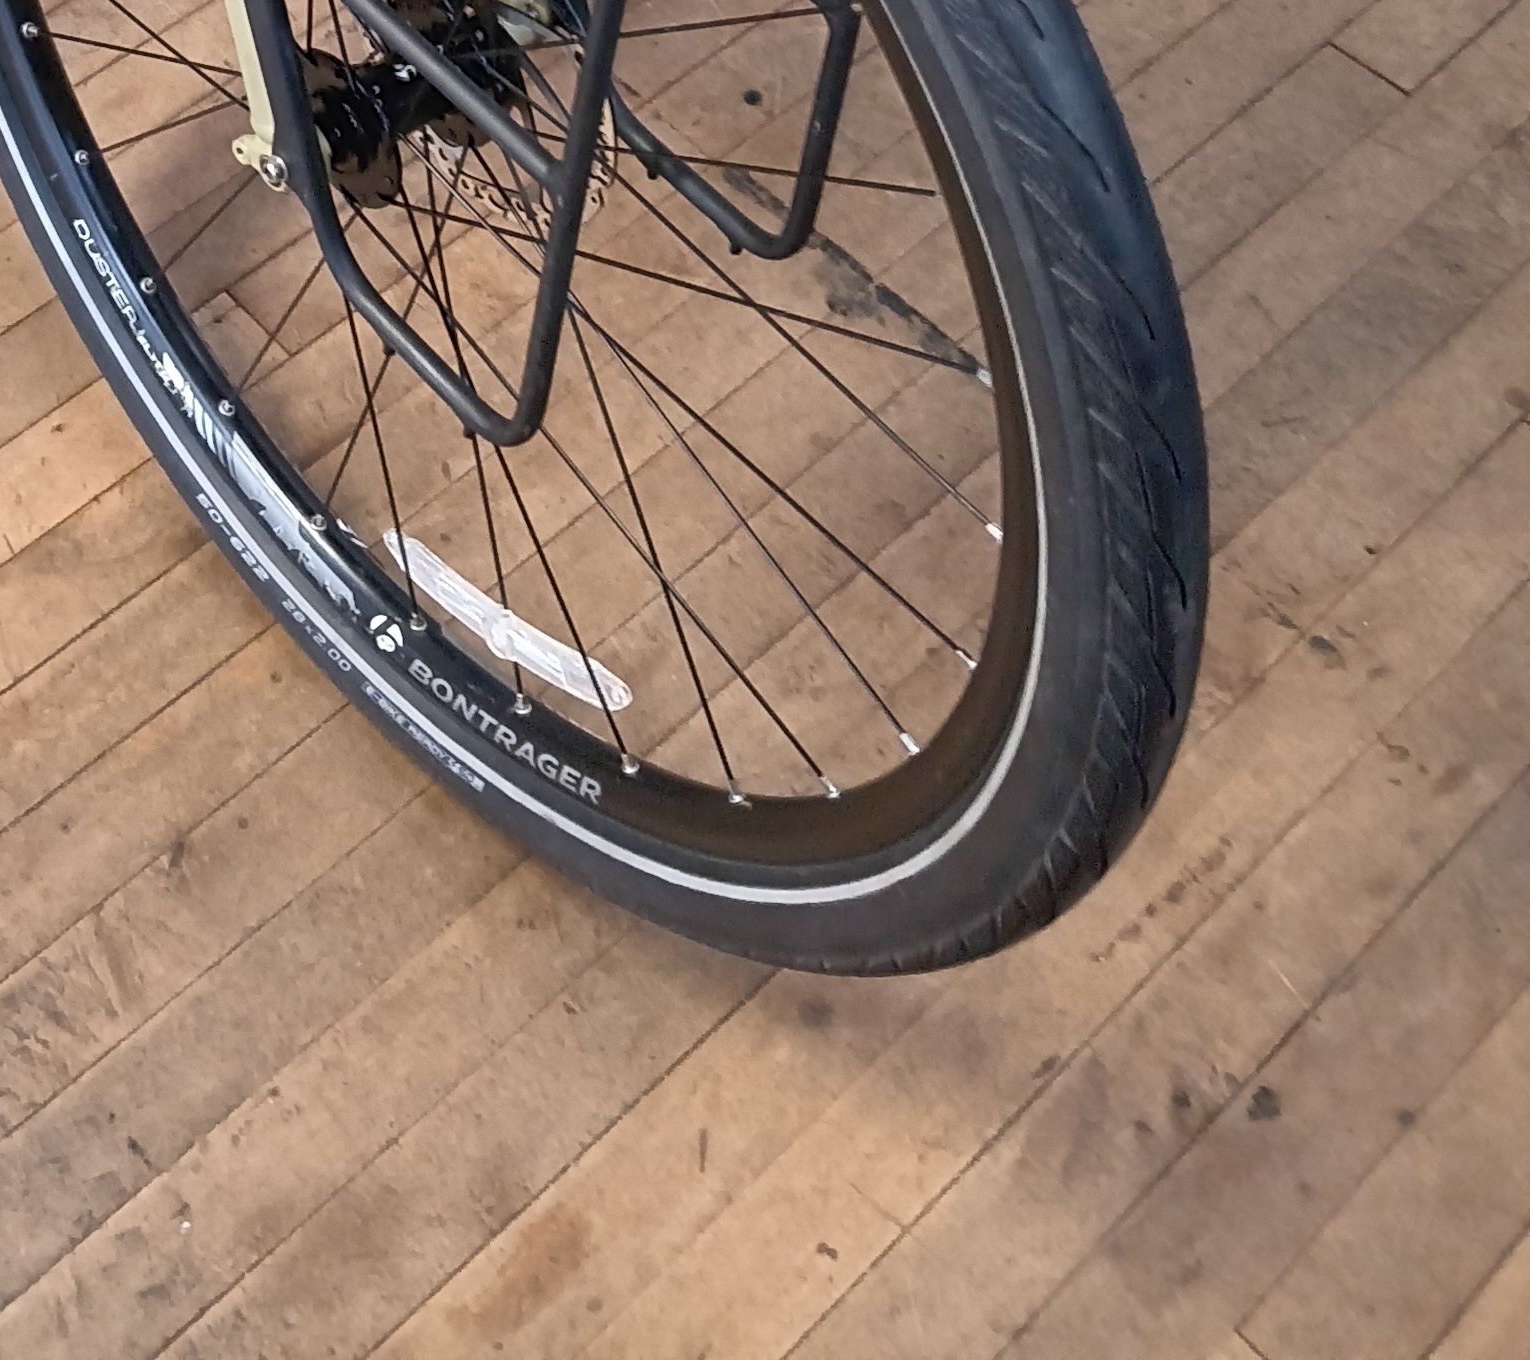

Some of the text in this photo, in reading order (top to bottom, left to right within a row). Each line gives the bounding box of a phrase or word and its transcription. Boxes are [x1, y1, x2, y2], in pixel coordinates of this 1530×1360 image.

[72, 218, 141, 332] DUSTER
[195, 492, 271, 584] 50-622
[406, 658, 604, 806] BONTRAGER
